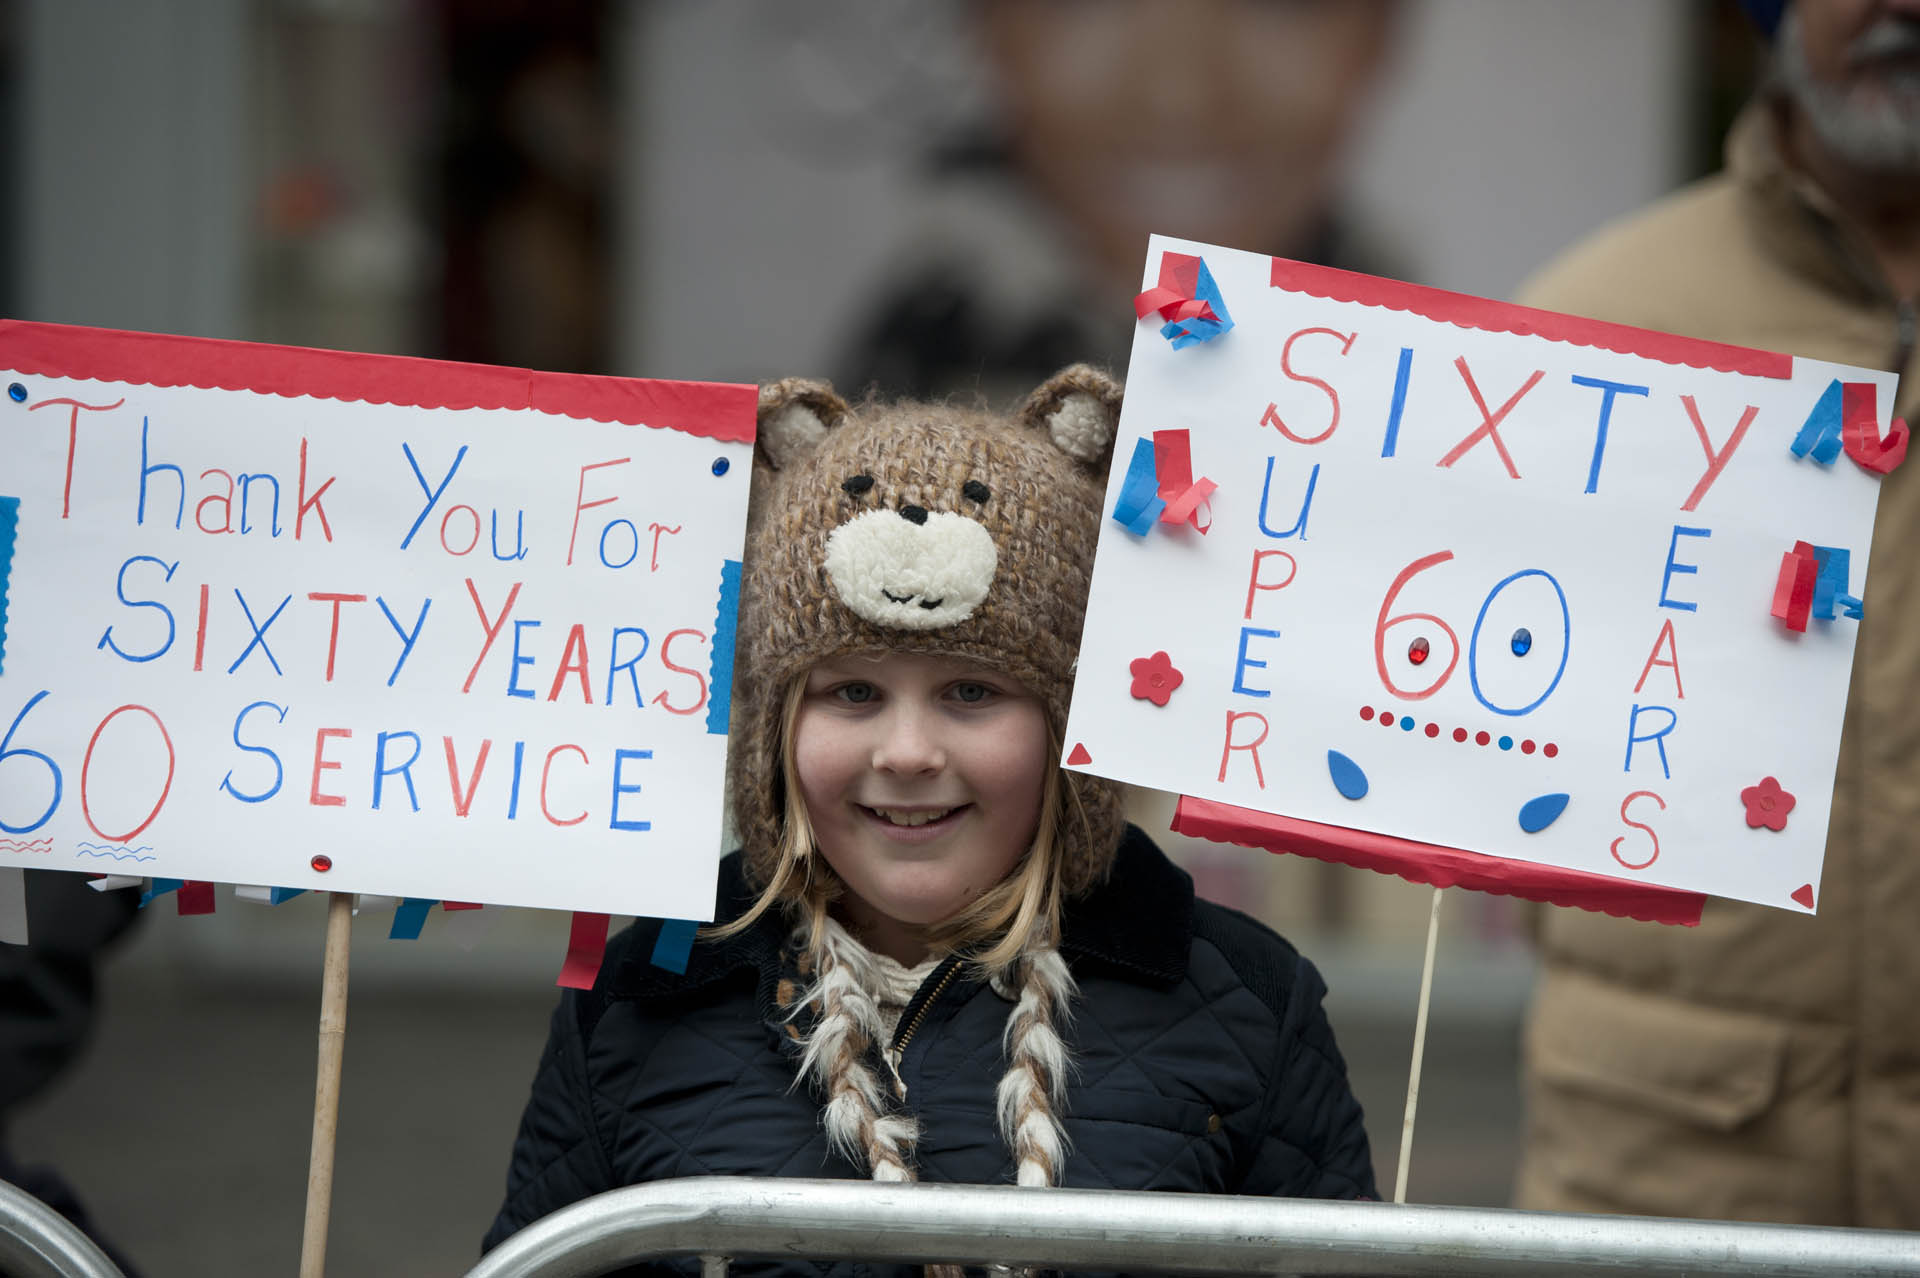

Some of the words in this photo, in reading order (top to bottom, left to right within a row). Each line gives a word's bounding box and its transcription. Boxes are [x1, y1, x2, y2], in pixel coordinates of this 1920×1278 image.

[28, 396, 337, 543] Thank
[400, 442, 528, 561] You
[568, 458, 682, 572] For
[1259, 326, 1759, 512] SIXTY
[98, 555, 432, 687] SIXTY
[463, 578, 708, 716] YEARS
[1374, 550, 1571, 716] 60
[0, 691, 175, 842] 60
[220, 701, 653, 832] SERVICE
